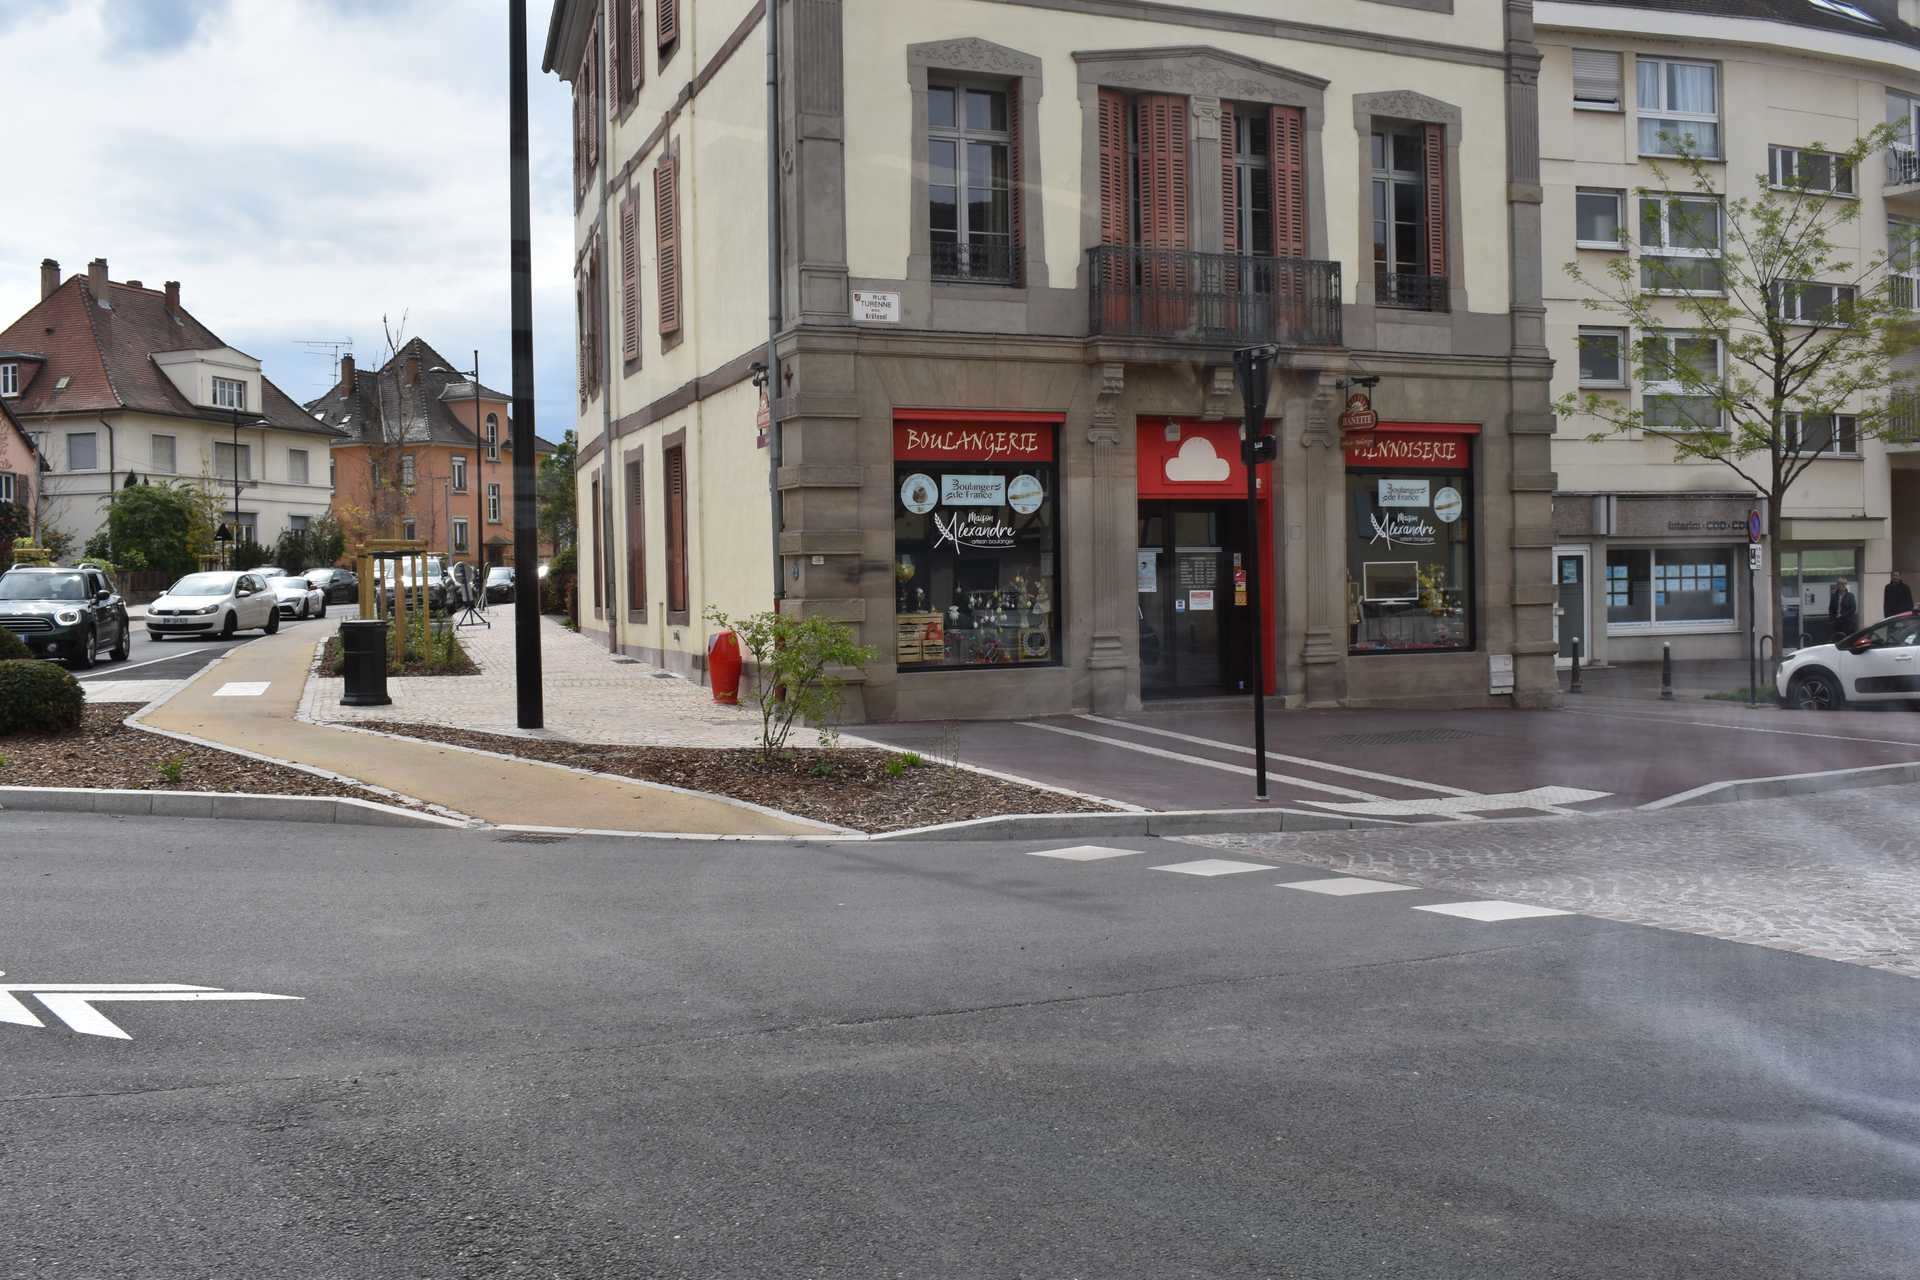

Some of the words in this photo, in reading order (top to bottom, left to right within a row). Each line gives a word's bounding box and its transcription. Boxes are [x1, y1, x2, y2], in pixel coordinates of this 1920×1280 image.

[861, 300, 892, 308] TURENNE
[906, 428, 1038, 461] BOULANGERIE
[966, 491, 993, 499] France
[967, 512, 994, 523] Maison
[1731, 520, 1748, 530] CD
[933, 511, 1016, 555] Alexandre
[1370, 512, 1436, 550] Alexandre
